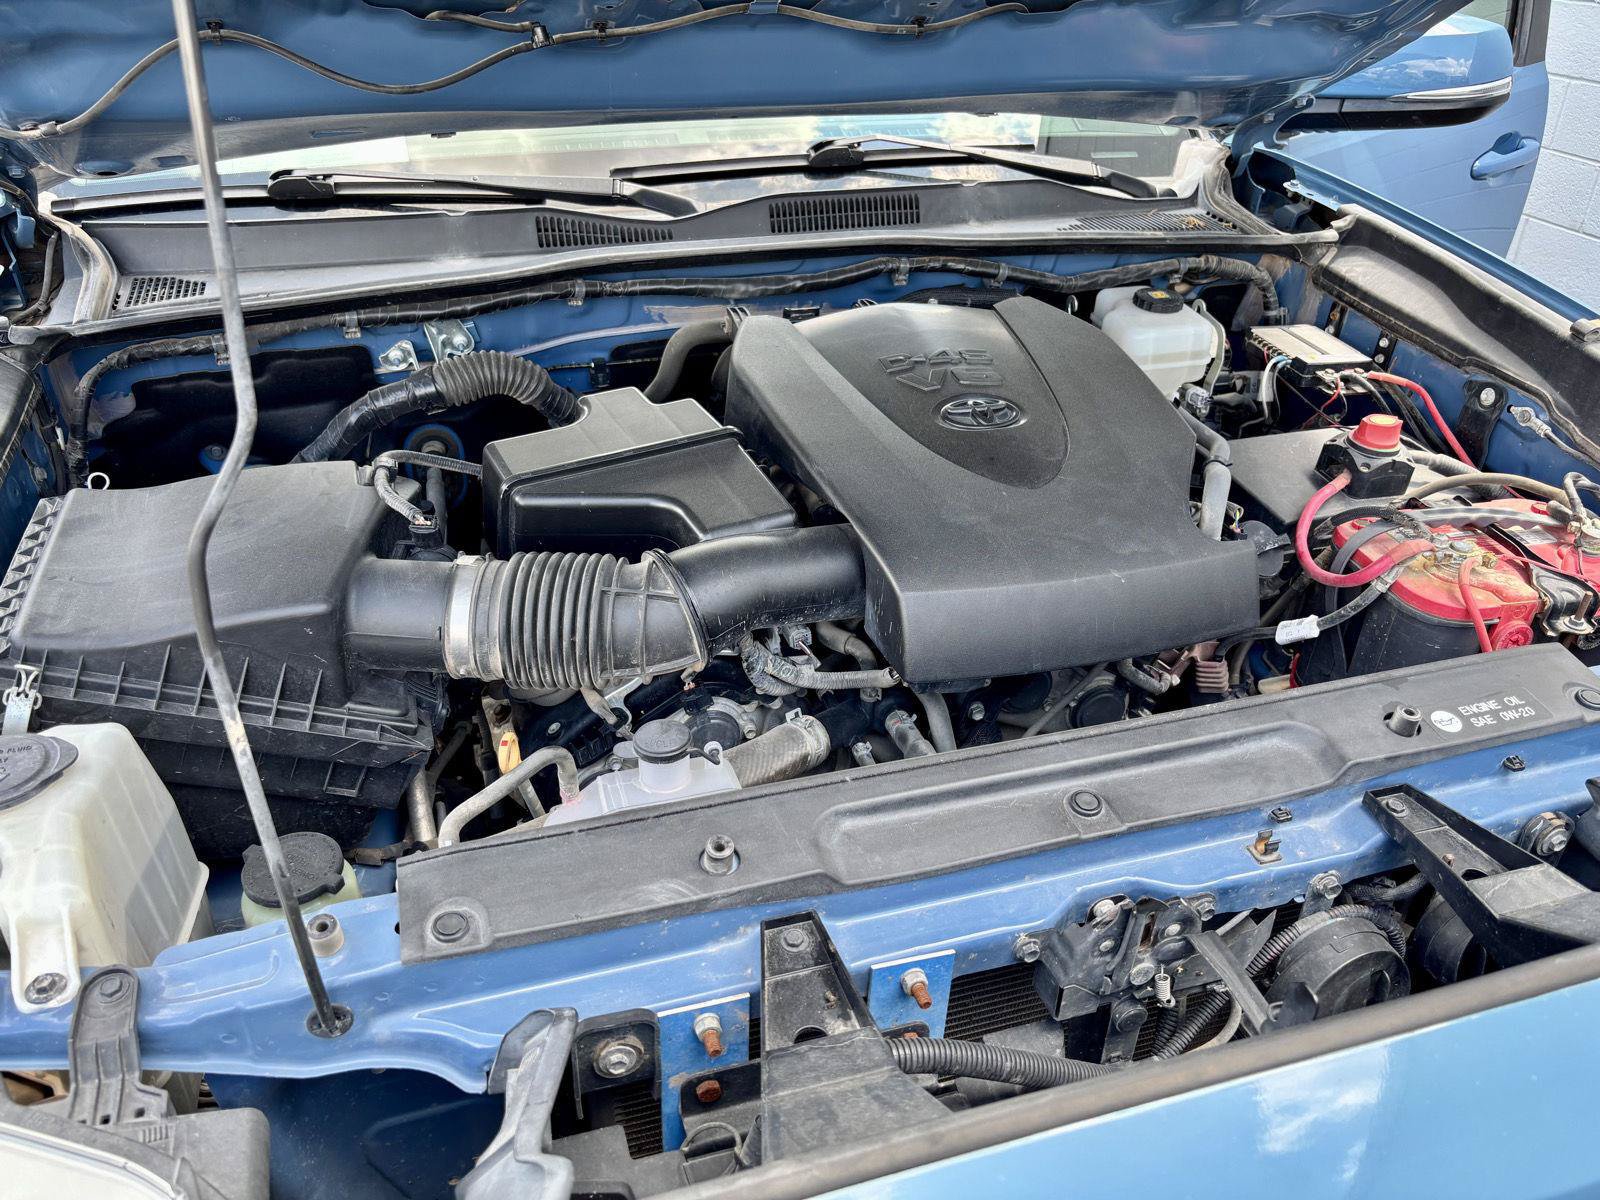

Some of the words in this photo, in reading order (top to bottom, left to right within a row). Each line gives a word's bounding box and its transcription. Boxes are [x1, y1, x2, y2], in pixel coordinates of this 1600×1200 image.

[895, 367, 1004, 391] V6
[1457, 700, 1502, 716] ENGINE
[1503, 695, 1526, 706] OIL
[1470, 714, 1497, 727] SAE
[1499, 706, 1536, 721] 0W-20
